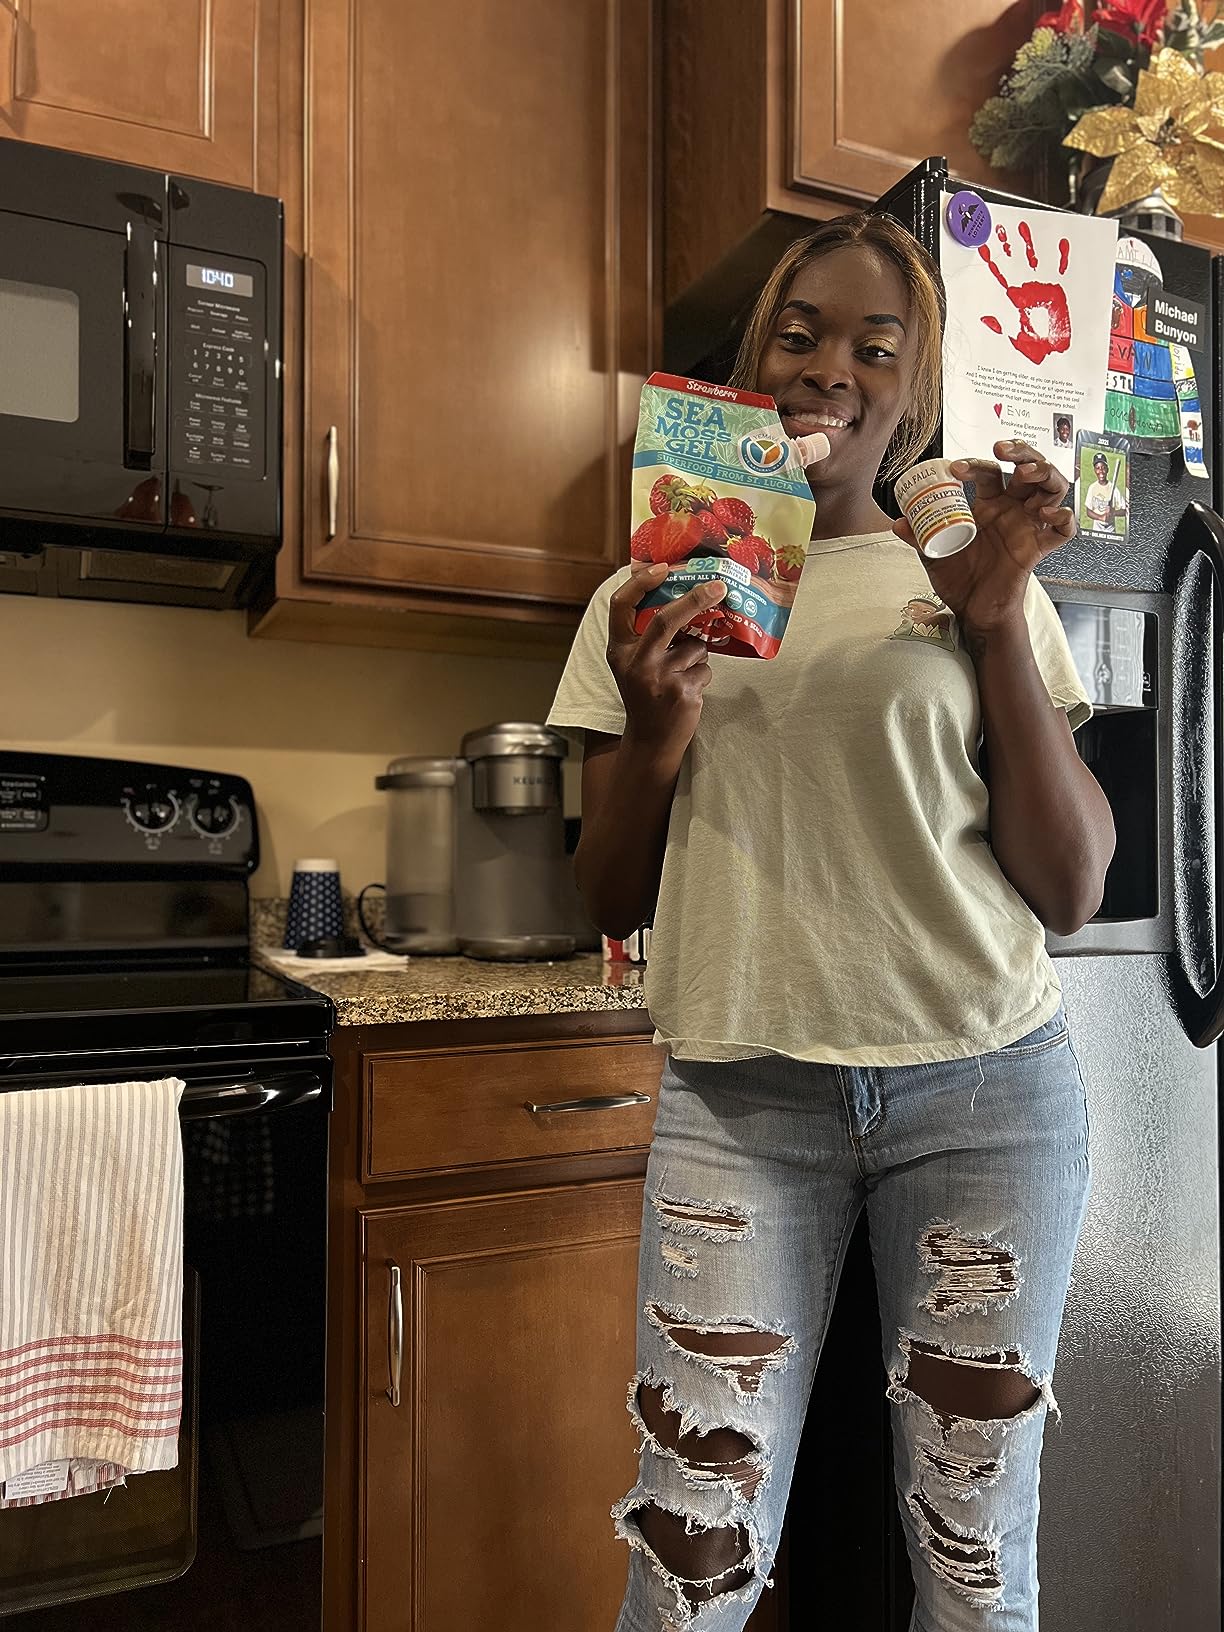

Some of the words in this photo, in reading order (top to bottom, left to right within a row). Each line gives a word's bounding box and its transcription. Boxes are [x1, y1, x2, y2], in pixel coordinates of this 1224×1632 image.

[968, 210, 983, 236] MINNESOTA
[972, 216, 986, 238] LOTTERY
[1154, 300, 1198, 326] Michael
[1154, 320, 1197, 344] Bunyon
[686, 381, 738, 400] Strawberry
[664, 397, 726, 431] SEA
[1007, 405, 1030, 418] Evan
[1038, 399, 1061, 408] Elementary
[654, 416, 733, 443] MOSS
[1024, 423, 1050, 432] Elementary
[664, 438, 717, 462] GEL
[656, 453, 713, 474] SUPERFOOD
[716, 469, 746, 484] FROM
[746, 475, 761, 486] ST.
[763, 478, 794, 492] LUCIA
[912, 466, 936, 484] FALLS
[690, 558, 715, 571] +92
[712, 574, 737, 588] NATURAL
